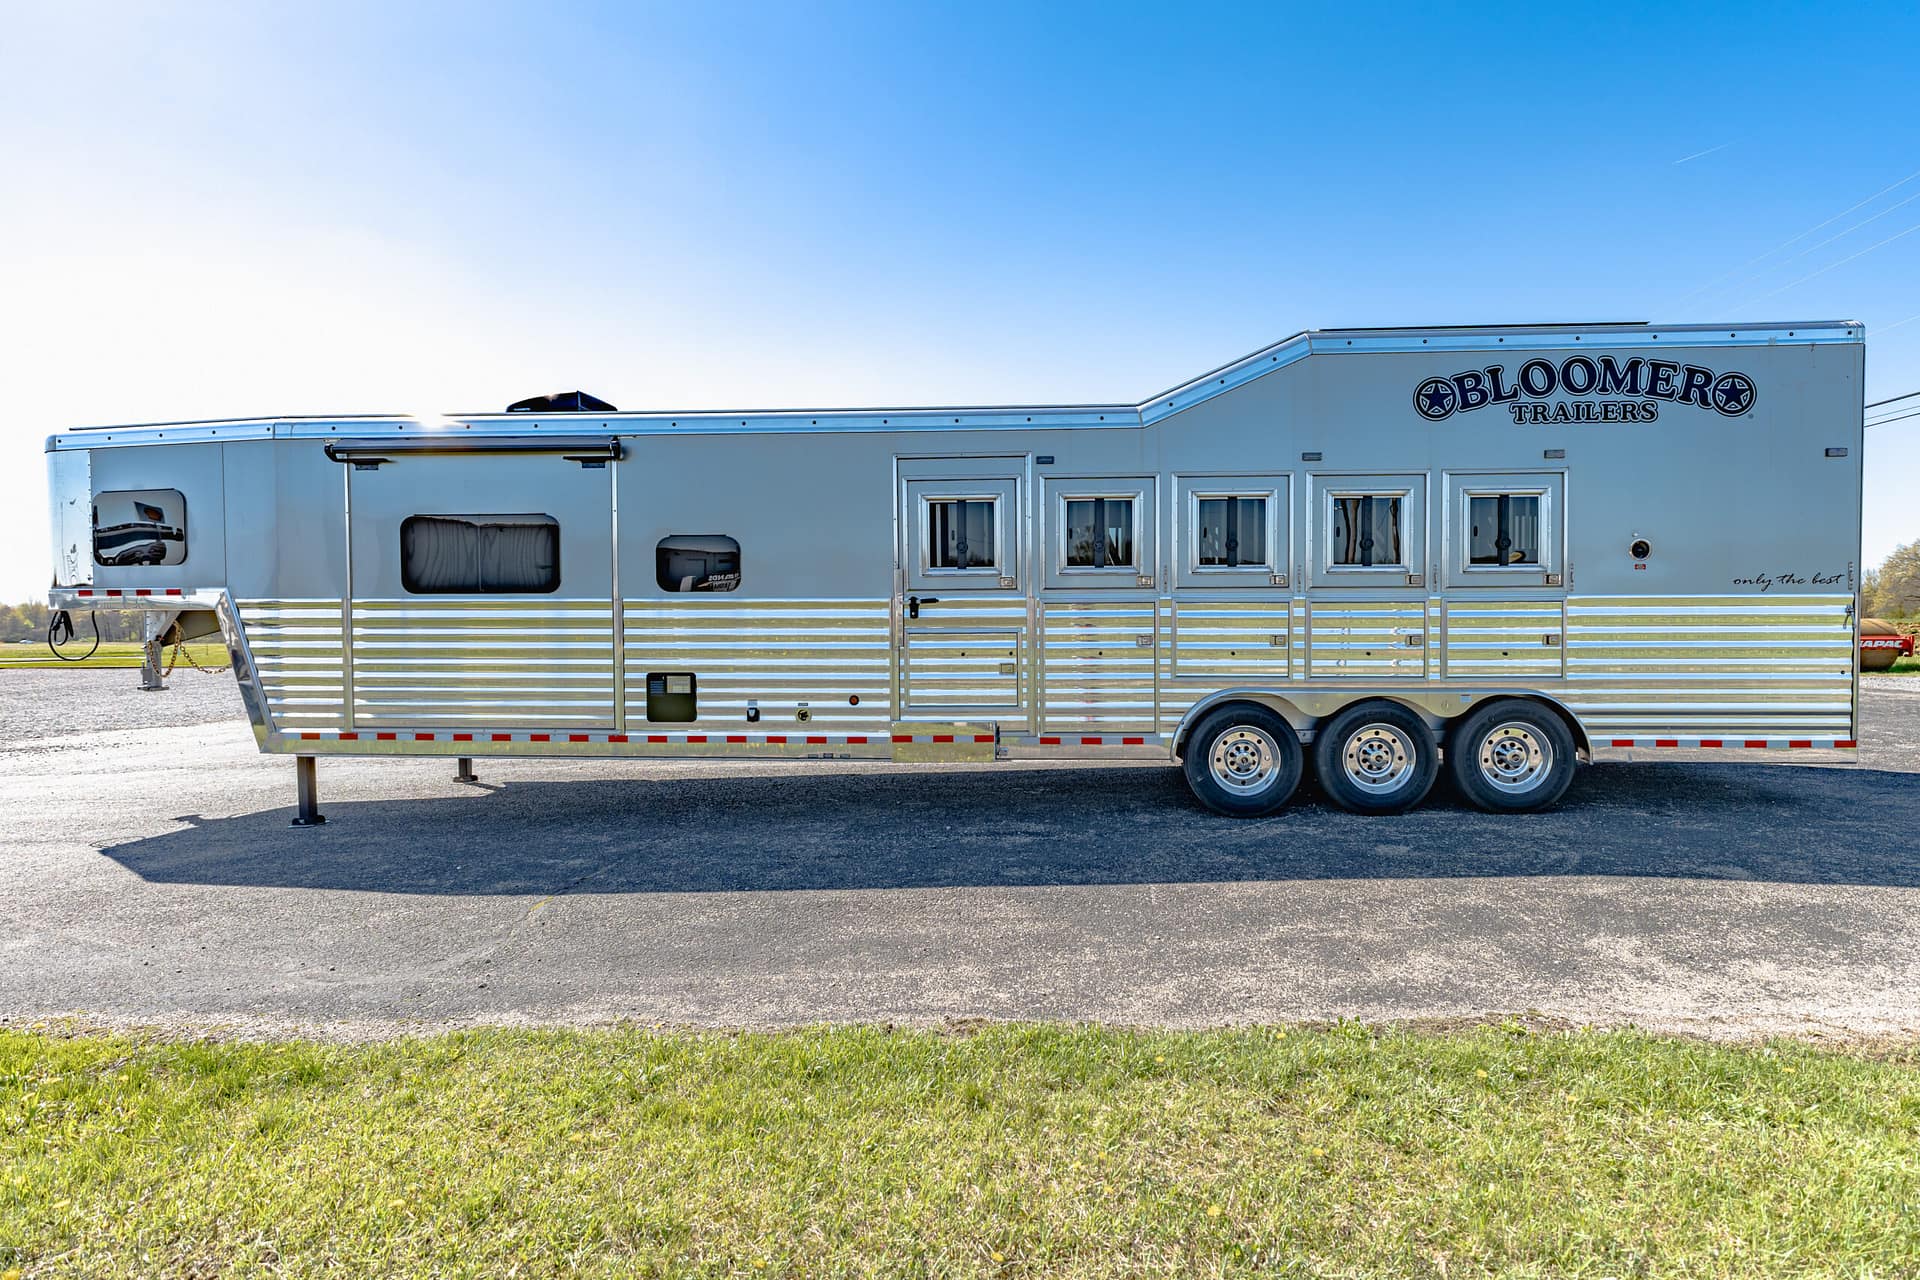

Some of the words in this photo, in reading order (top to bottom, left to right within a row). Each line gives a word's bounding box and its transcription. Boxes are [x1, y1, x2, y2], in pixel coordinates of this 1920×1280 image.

[1450, 355, 1716, 413] BLOOMER
[1509, 401, 1659, 425] TRAILERS
[1733, 573, 1773, 592] only
[1776, 573, 1807, 585] the
[1811, 572, 1845, 585] best
